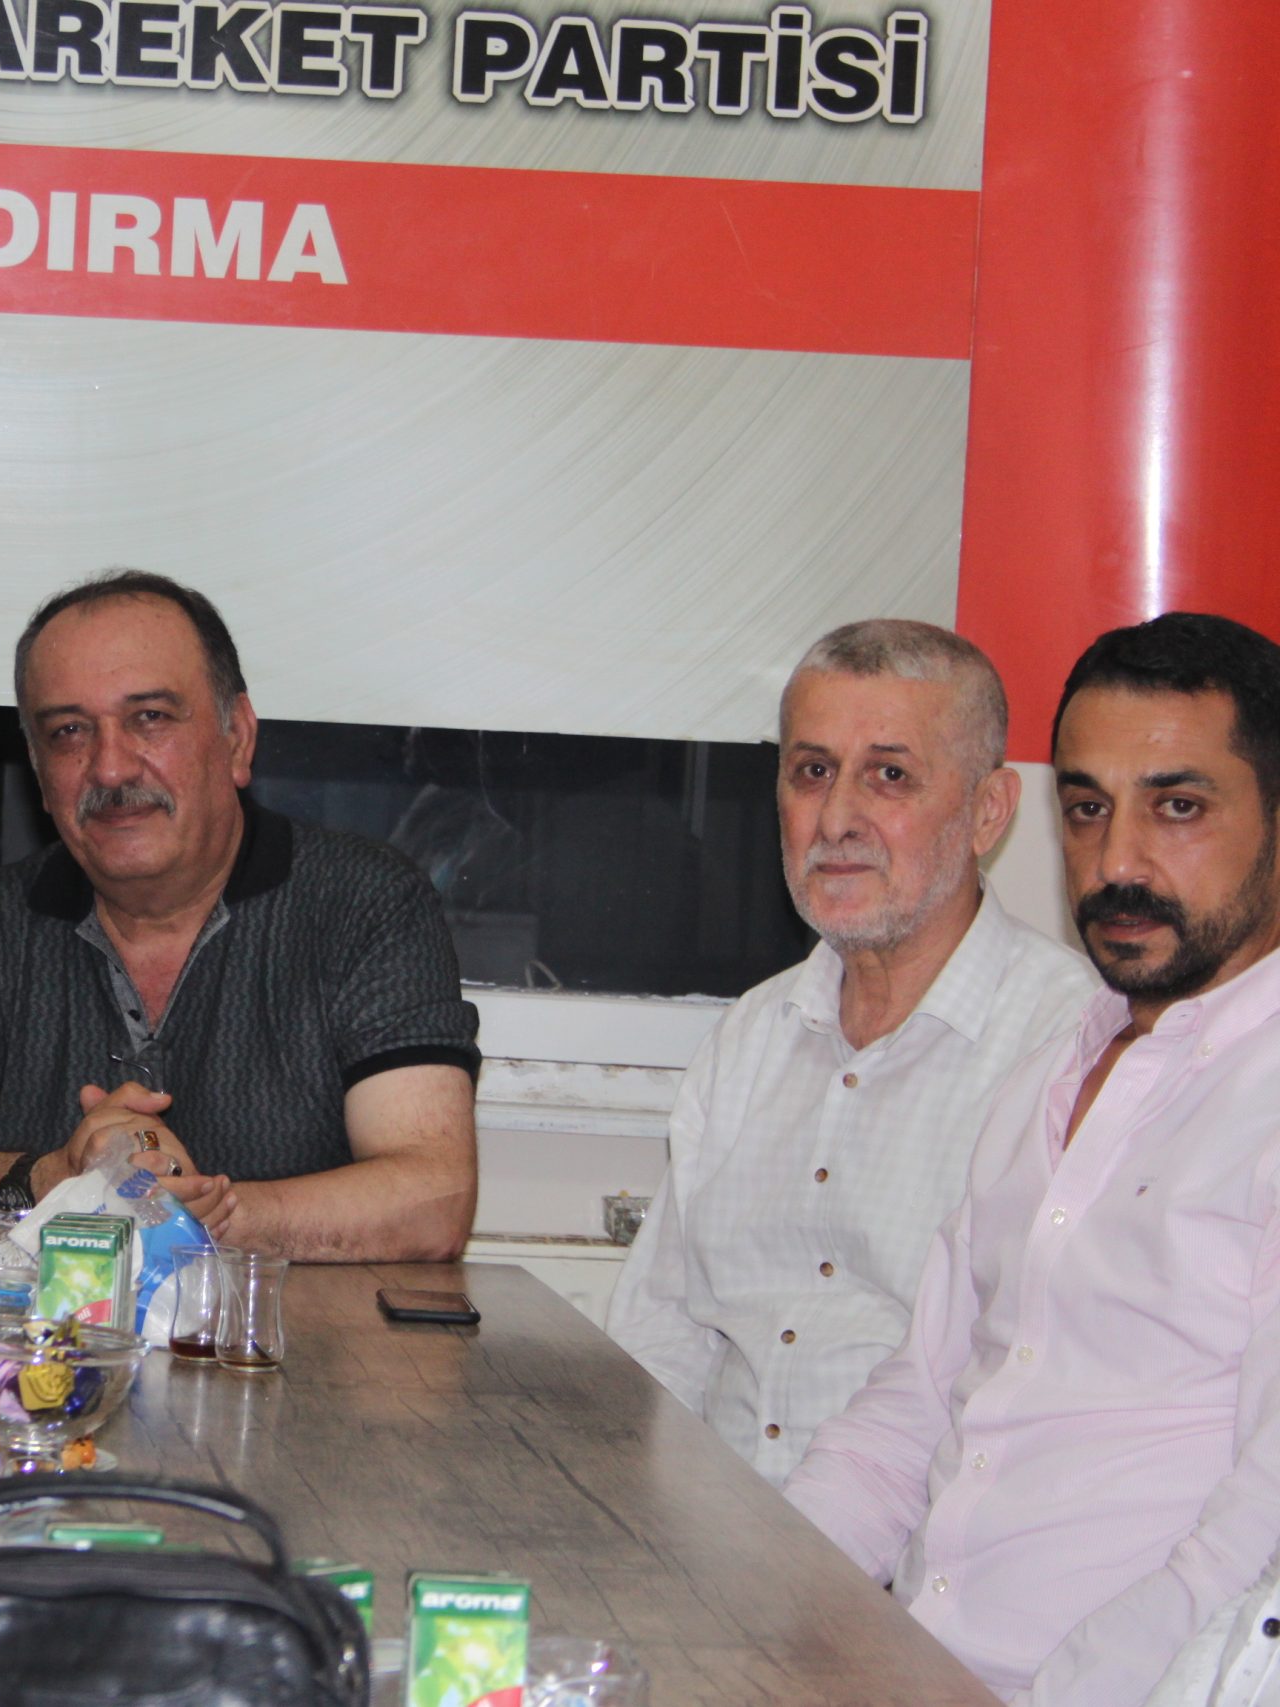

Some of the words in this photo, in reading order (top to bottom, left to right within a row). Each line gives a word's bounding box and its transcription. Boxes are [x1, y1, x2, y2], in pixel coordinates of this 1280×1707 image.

[453, 4, 929, 124] PARTİSİ
[45, 1235, 112, 1249] aroma
[421, 1590, 524, 1611] aroma
